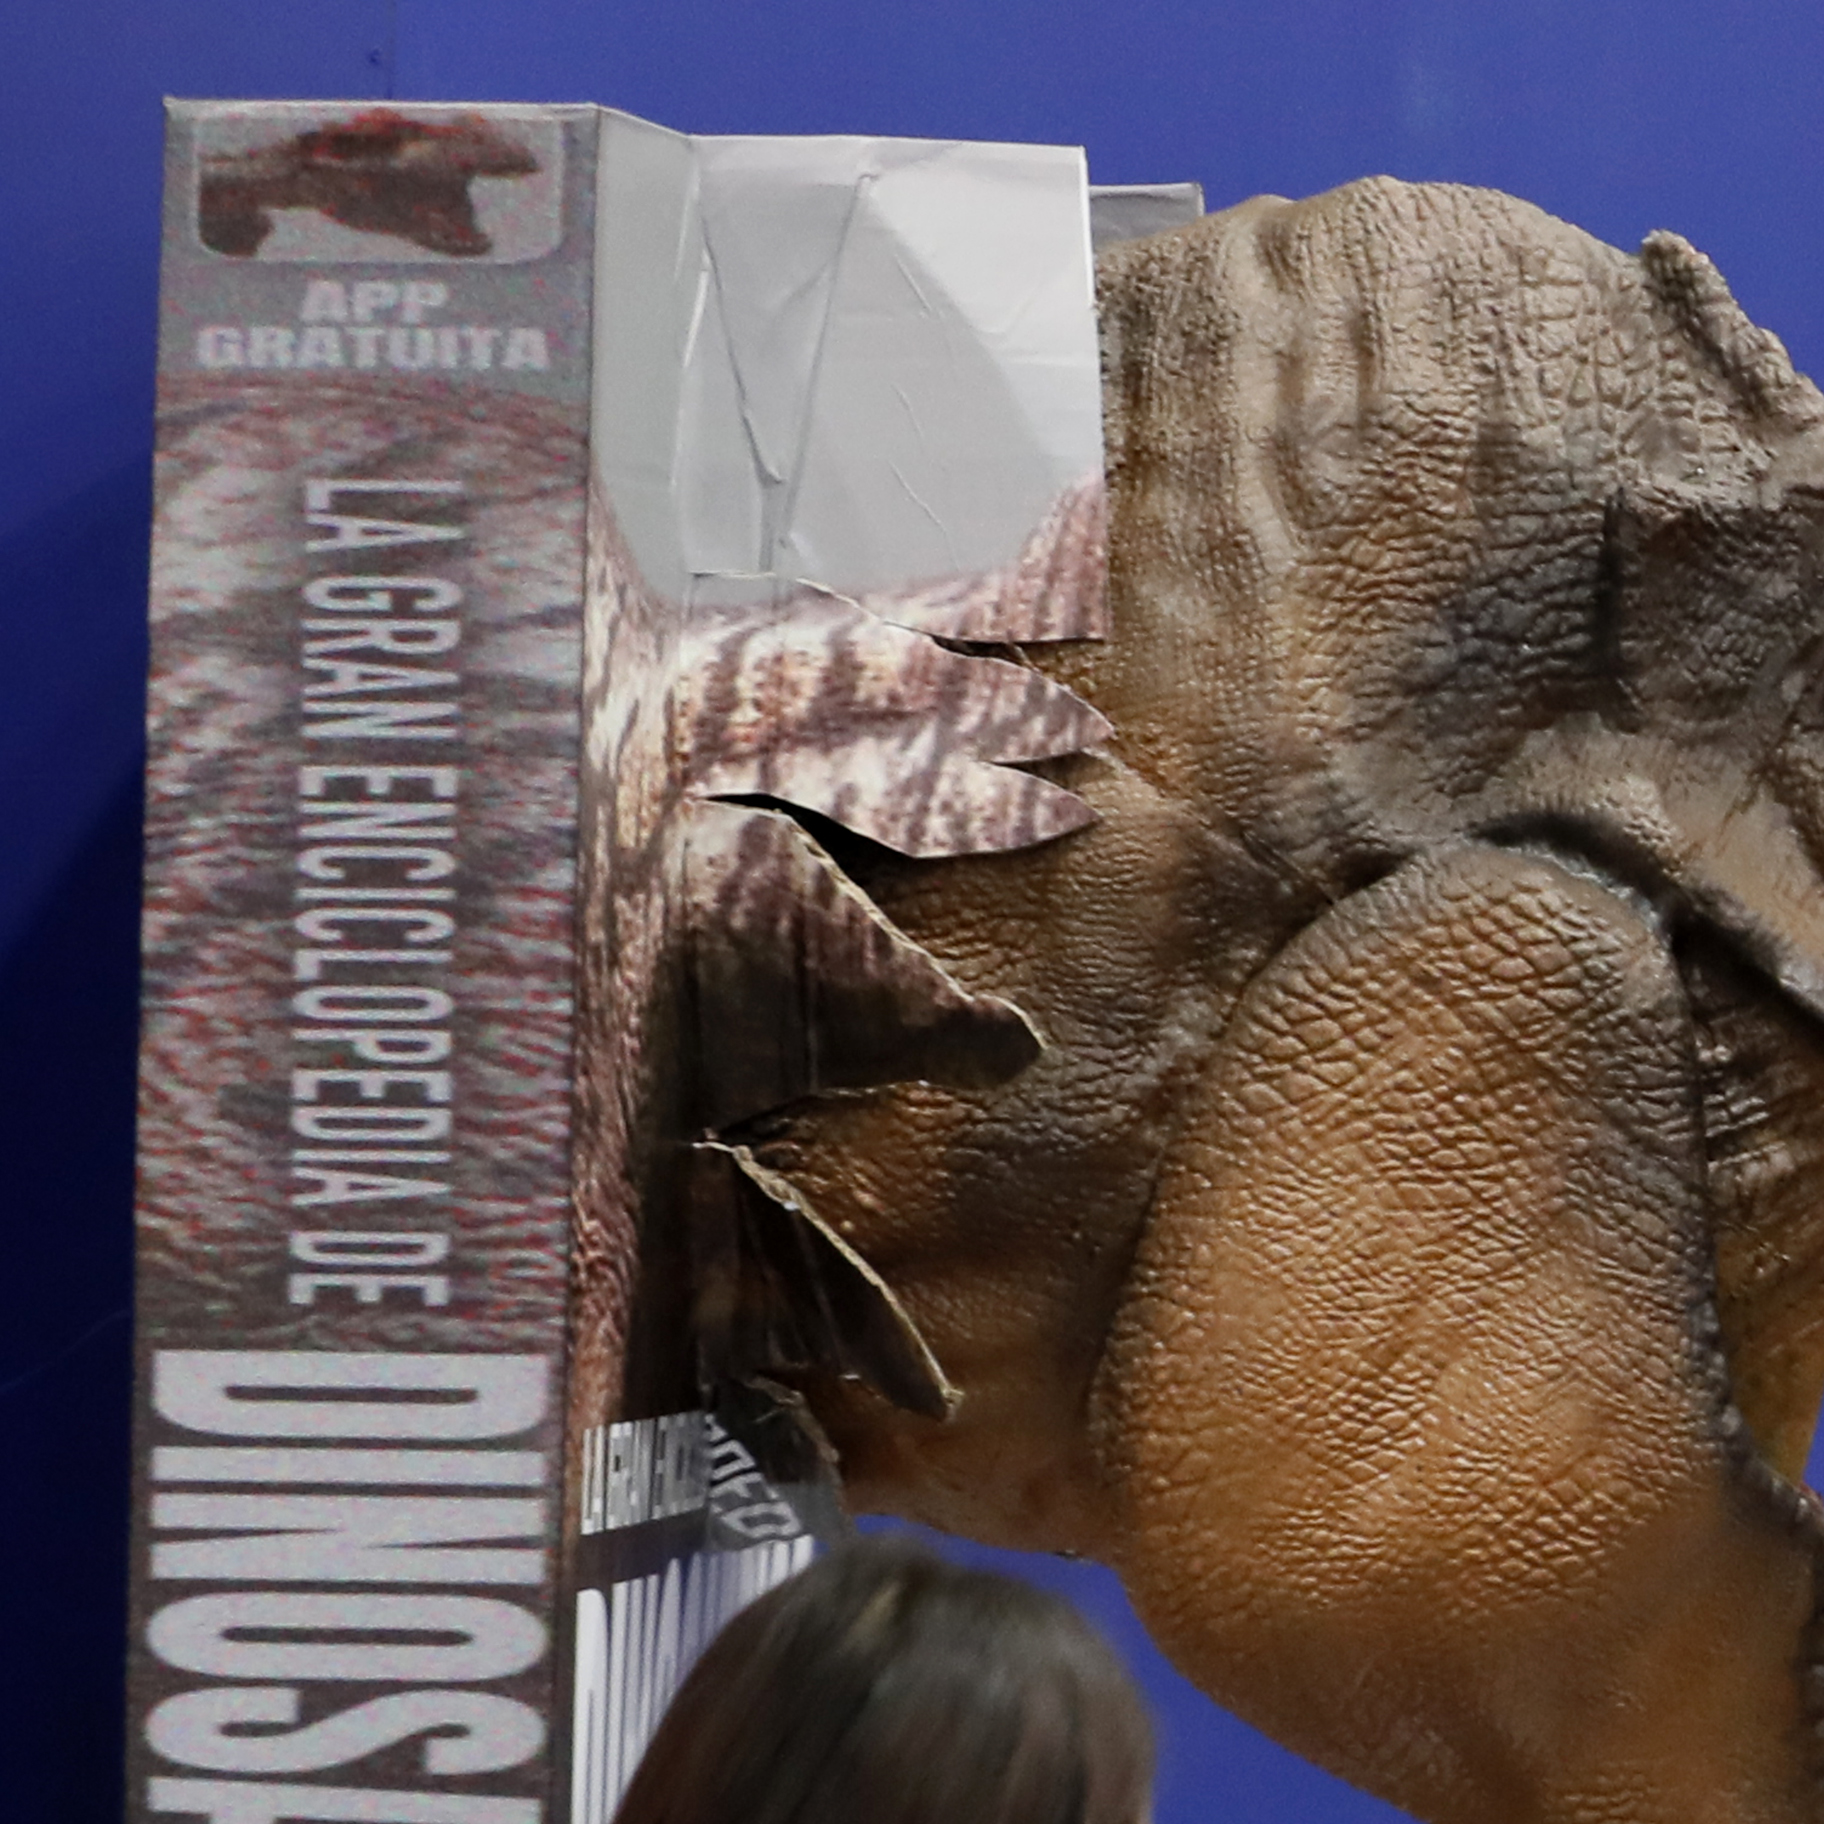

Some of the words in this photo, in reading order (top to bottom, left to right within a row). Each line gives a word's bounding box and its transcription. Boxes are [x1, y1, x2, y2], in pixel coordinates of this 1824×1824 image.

[300, 280, 448, 322] APP
[198, 326, 550, 369] GRATUITA
[306, 478, 464, 552] LA
[304, 575, 464, 740] GRAN
[288, 763, 462, 1209] ENCICLOPEDIA
[286, 1230, 452, 1308] DE
